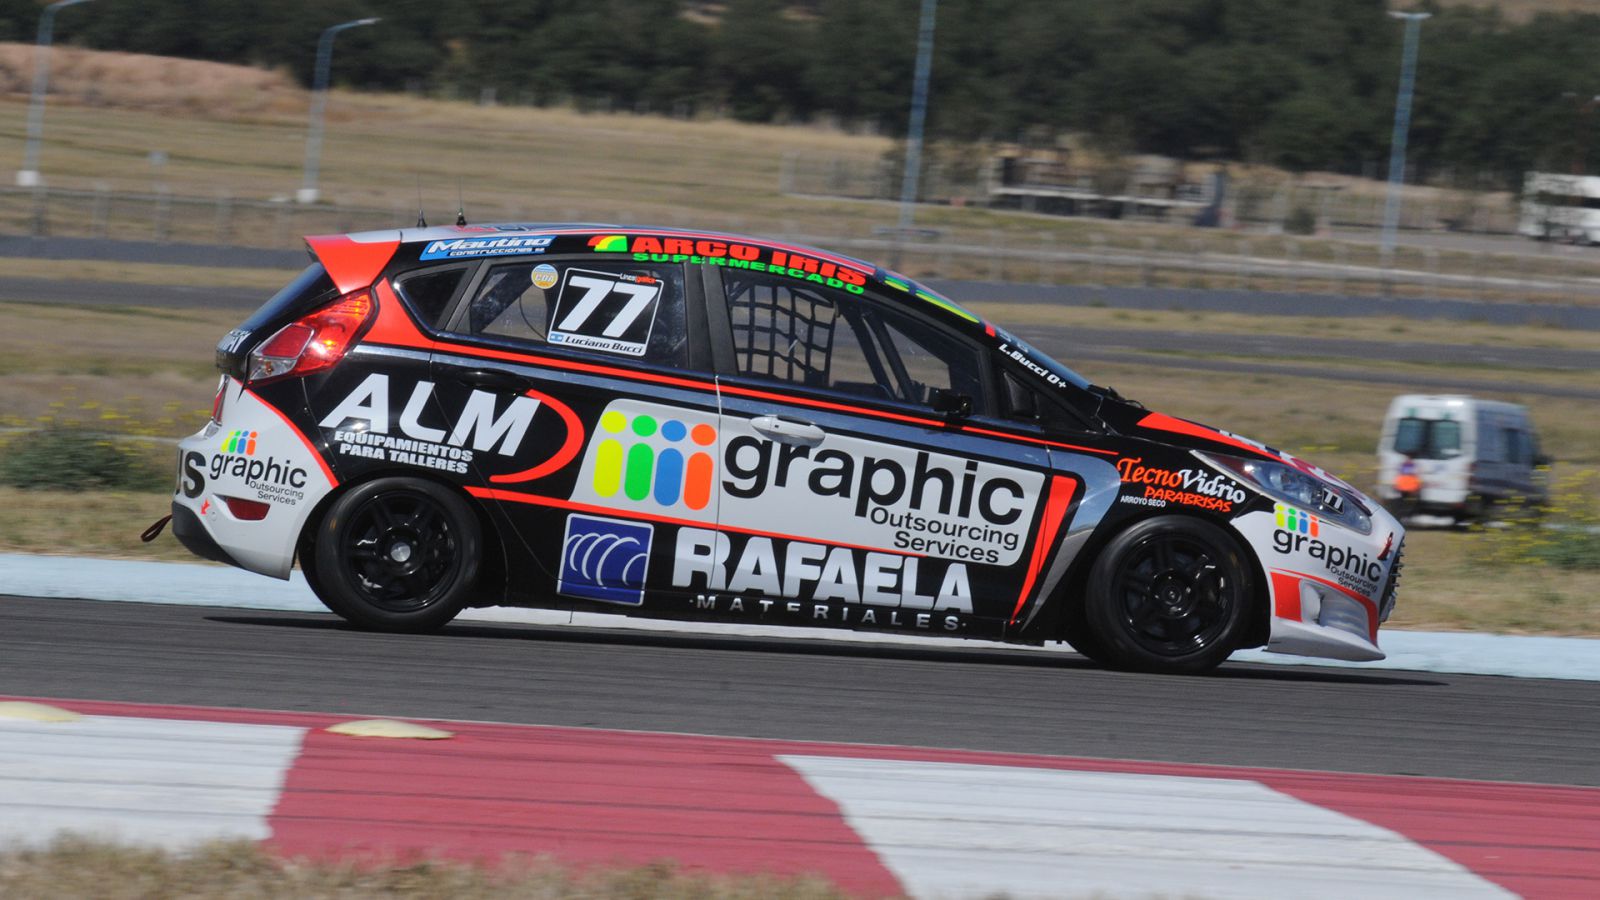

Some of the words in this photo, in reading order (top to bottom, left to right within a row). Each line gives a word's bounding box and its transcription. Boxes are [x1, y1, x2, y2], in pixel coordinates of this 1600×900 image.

[428, 237, 551, 254] Mautino
[631, 236, 760, 261] ARCO
[772, 251, 867, 287] IRIS
[632, 253, 864, 295] SUPERMERCADO
[558, 275, 659, 338] 77
[564, 336, 610, 349] Luciano
[613, 341, 643, 354] Bucci
[318, 373, 542, 457] ALM
[334, 431, 473, 462] EQUIPAMIENTOS
[340, 443, 385, 460] PARA
[390, 449, 468, 474] TALLERES
[210, 452, 307, 488] graphic
[722, 435, 1025, 525] graphic
[1116, 457, 1246, 504] TecnoVidrio
[249, 480, 304, 499] Outsourcing
[257, 491, 297, 506] Services
[1120, 495, 1147, 506] ARROYO
[1148, 497, 1166, 508] SECO
[1144, 485, 1233, 513] PARABRISAS
[870, 506, 1019, 551] Outsourcing
[894, 531, 999, 564] Services
[1273, 528, 1382, 583] graphic
[672, 526, 974, 614] RAFAELA
[1330, 565, 1378, 593] Outsourcing
[1338, 577, 1371, 597] Services
